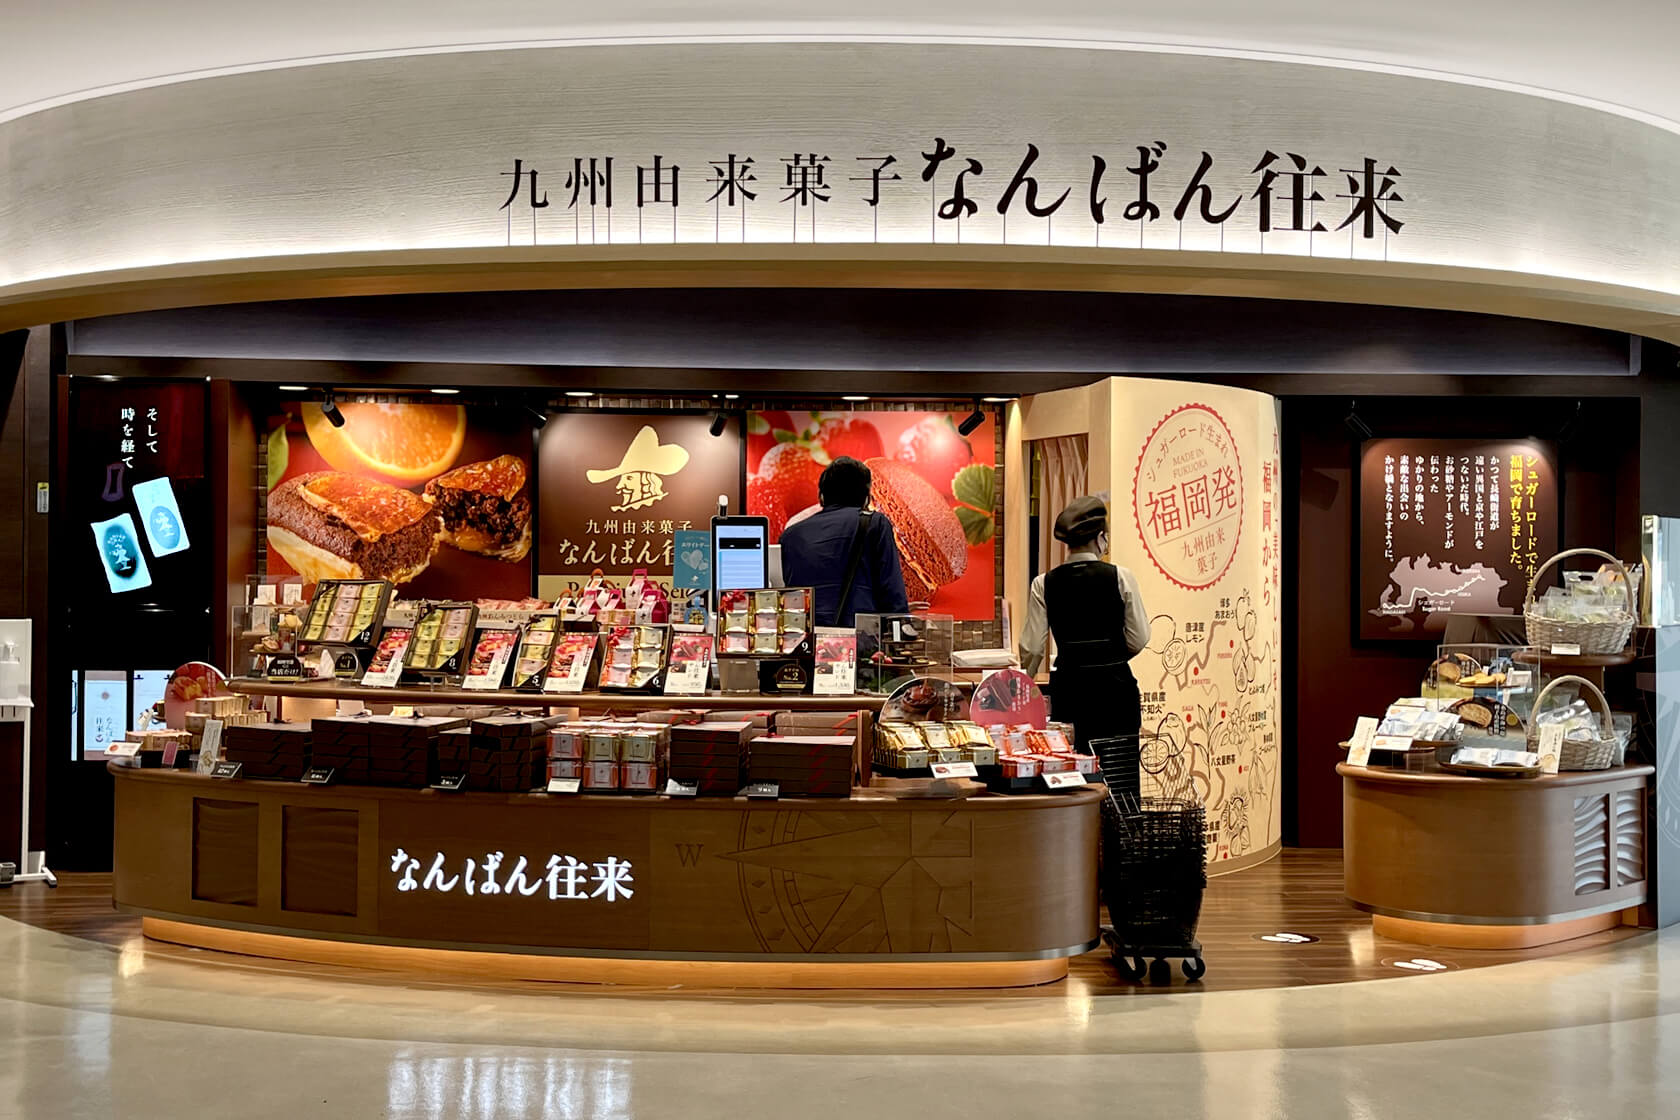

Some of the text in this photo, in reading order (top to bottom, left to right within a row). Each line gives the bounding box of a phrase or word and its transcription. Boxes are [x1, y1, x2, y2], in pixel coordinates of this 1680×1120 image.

[499, 137, 1405, 239] 九州由来菓子 なんばん往来
[121, 407, 136, 469] 時を経て
[146, 407, 158, 453] そして
[1172, 448, 1205, 467] MADE IN
[1173, 458, 1208, 480] FUKUOKA
[1430, 455, 1440, 493] 伝わった
[1144, 465, 1237, 540] 福岡発
[1399, 454, 1410, 521] 素敵な出会いの
[1444, 455, 1455, 550] お砂糖やアーモンドが
[585, 519, 693, 535] 九州由来菓子
[1262, 460, 1272, 607] 福岡から
[1510, 454, 1524, 571] 福岡で育ちました。
[1181, 527, 1226, 560] 九州由来
[1195, 551, 1218, 576] 菓子
[1214, 610, 1236, 619] あまおう
[1186, 634, 1205, 643] レモン
[391, 848, 634, 902] なんばん往来
[674, 843, 704, 868] W
